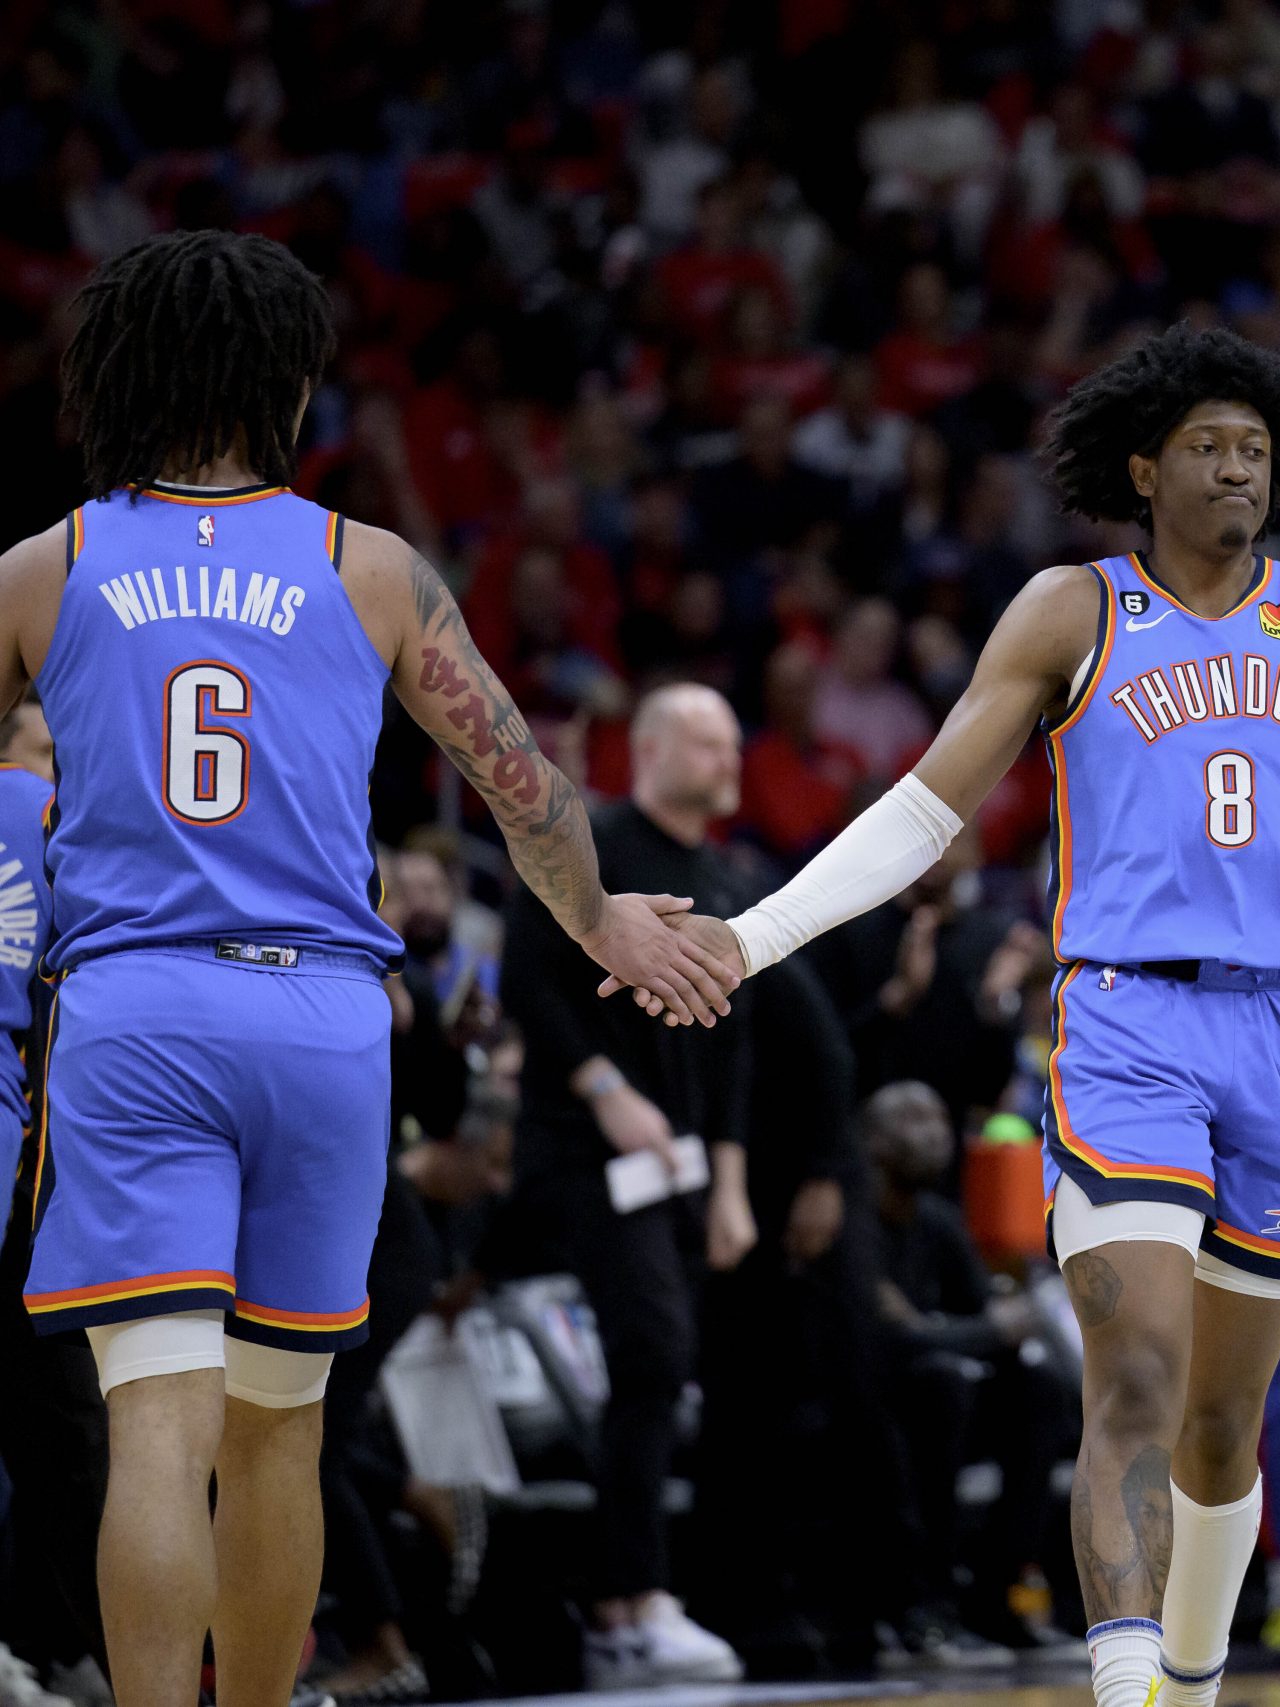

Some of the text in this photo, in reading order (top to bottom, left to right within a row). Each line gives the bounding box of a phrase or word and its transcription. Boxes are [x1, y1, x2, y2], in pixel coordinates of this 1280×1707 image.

[99, 567, 305, 635] WILLIAMS
[1125, 595, 1143, 613] 6
[162, 659, 251, 826] 6
[1204, 748, 1256, 848] 8
